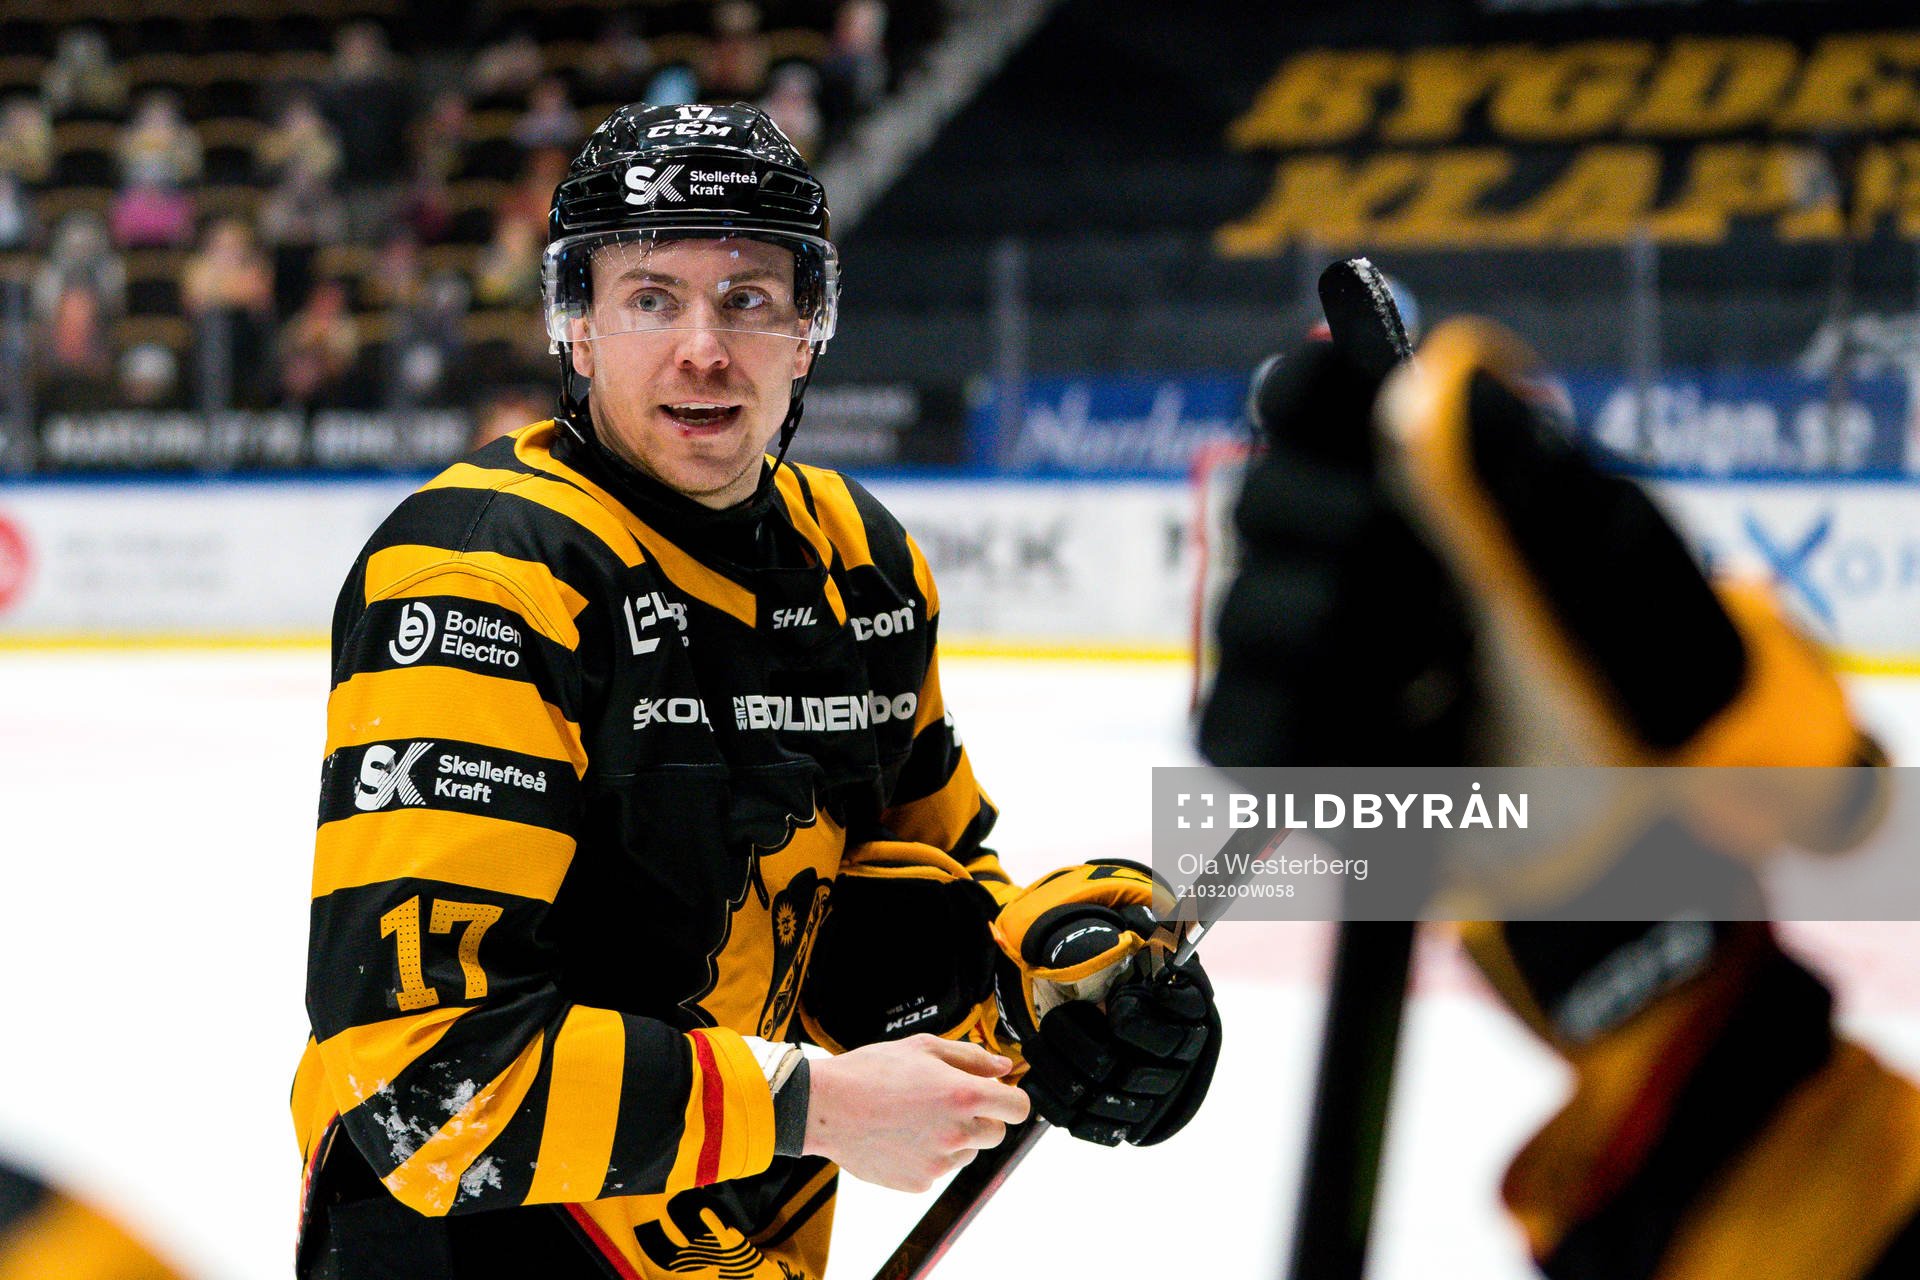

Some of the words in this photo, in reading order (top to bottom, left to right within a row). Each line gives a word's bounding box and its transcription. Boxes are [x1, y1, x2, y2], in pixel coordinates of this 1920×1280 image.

[674, 106, 714, 120] 17
[646, 121, 733, 138] CCM
[689, 169, 758, 185] Skellefteå
[689, 183, 725, 197] Kraft
[444, 610, 522, 648] Boliden
[772, 606, 818, 630] SHL
[440, 633, 520, 668] Electro
[745, 695, 869, 732] BOLIDEN
[437, 754, 548, 793] Skellefteå
[434, 777, 492, 803] Kraft
[380, 894, 504, 1012] 17
[1051, 925, 1113, 963] CCM
[885, 1005, 938, 1033] CCM
